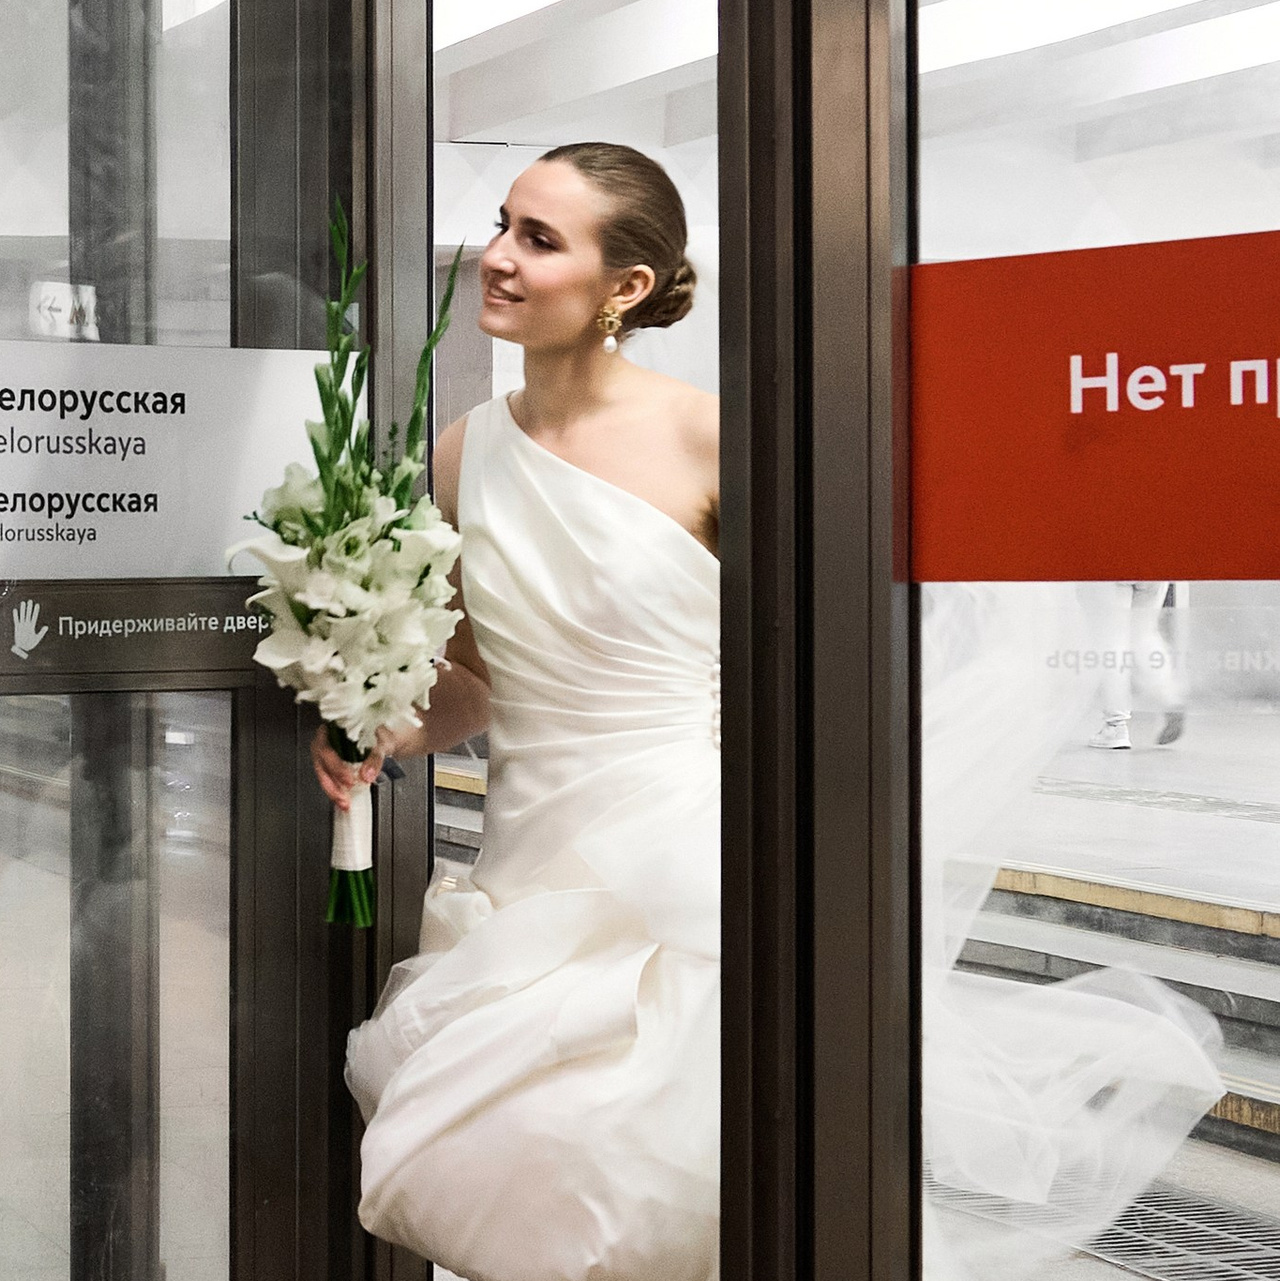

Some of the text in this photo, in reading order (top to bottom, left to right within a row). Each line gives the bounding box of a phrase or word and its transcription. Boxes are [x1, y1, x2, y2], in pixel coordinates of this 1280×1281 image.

[1070, 352, 1280, 419] Нет п
[58, 612, 272, 639] Придерживайте двер
